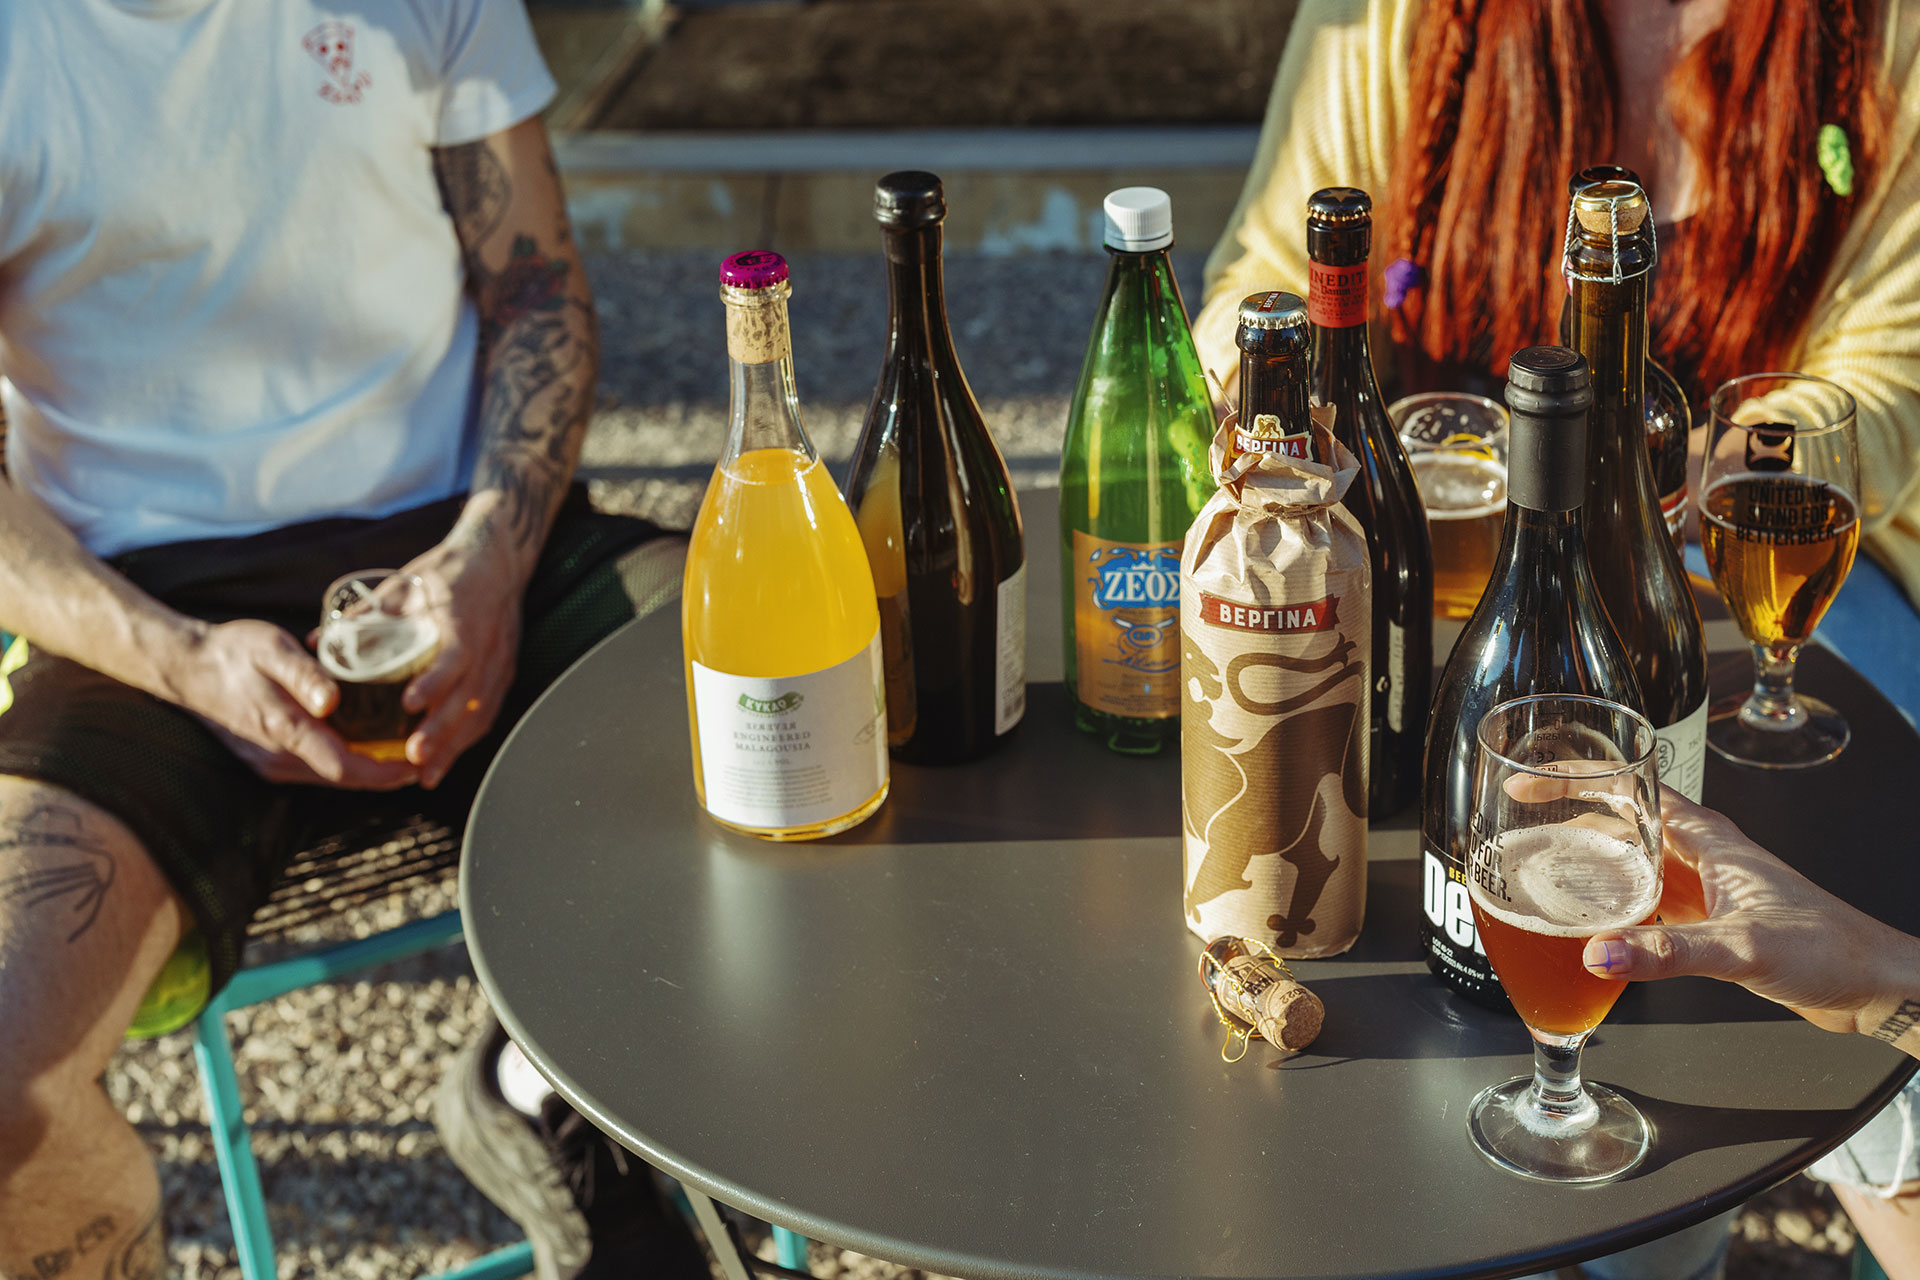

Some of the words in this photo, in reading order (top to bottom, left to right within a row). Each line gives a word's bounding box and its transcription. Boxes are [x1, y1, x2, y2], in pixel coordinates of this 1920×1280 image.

[1310, 268, 1364, 287] INEDIT
[1219, 603, 1317, 629] ΒΕΡΓΙΝΑ
[1478, 841, 1503, 874] FOR
[1449, 866, 1467, 886] BEE
[1474, 860, 1512, 903] BEER.
